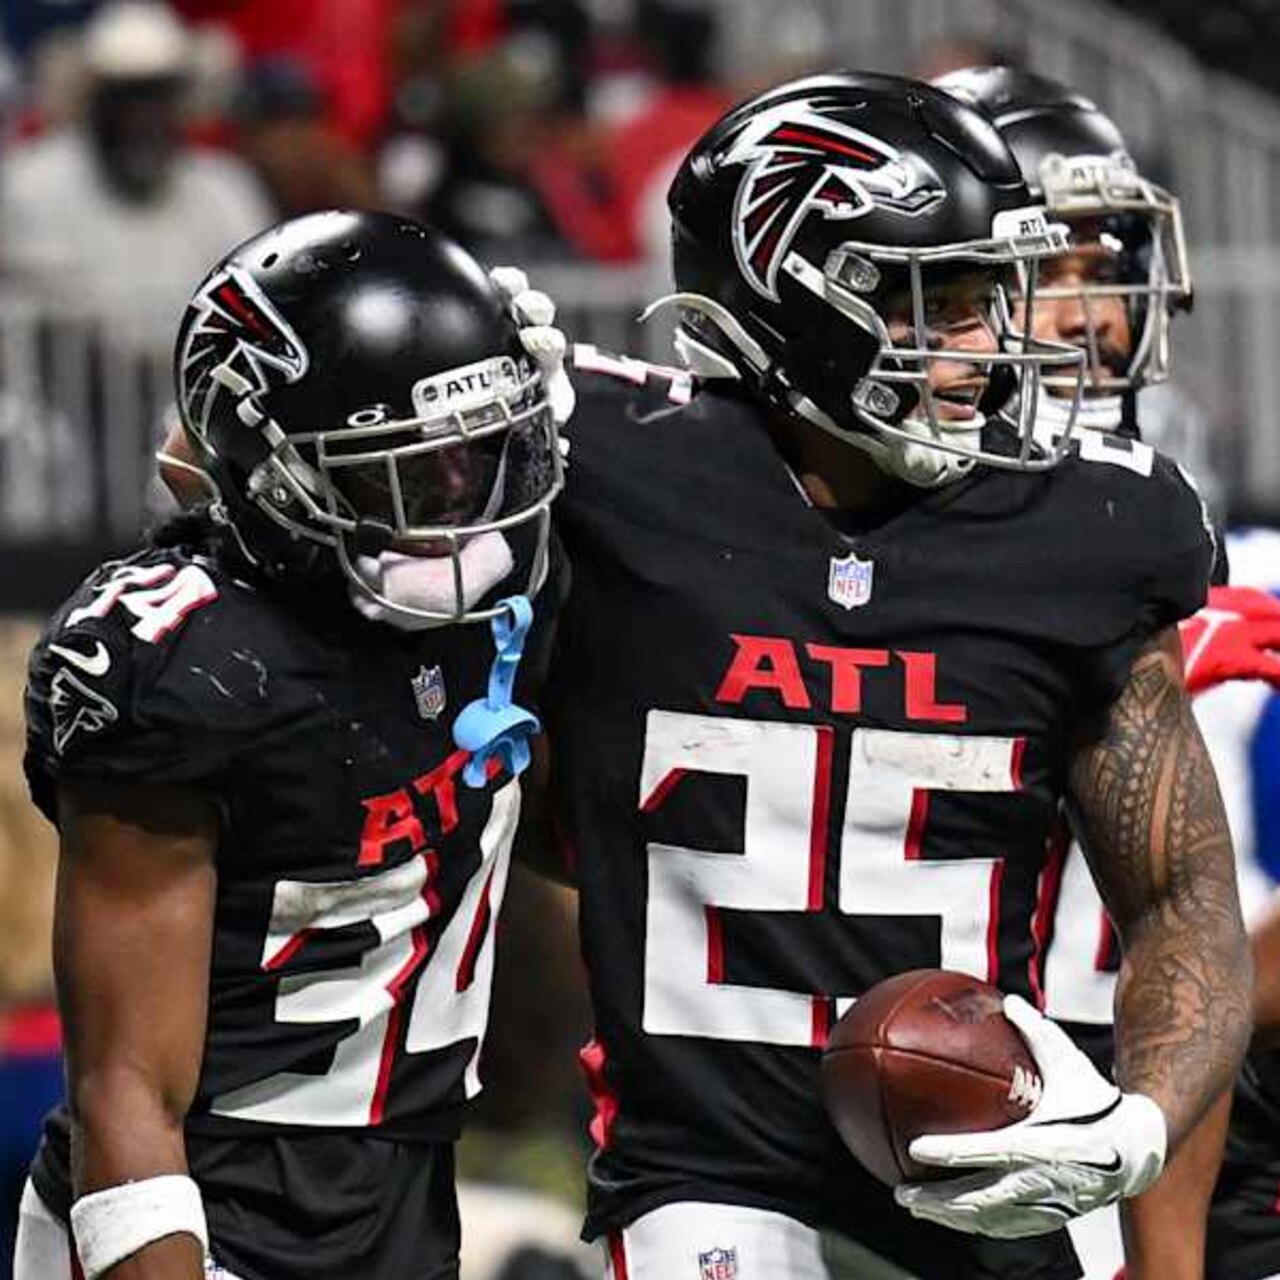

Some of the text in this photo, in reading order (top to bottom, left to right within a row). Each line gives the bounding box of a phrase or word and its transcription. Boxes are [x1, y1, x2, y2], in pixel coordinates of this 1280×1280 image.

[445, 371, 492, 400] ATL
[715, 633, 968, 723] ATL
[356, 748, 504, 867] AT
[638, 708, 1026, 1048] 25
[209, 772, 521, 1126] 34
